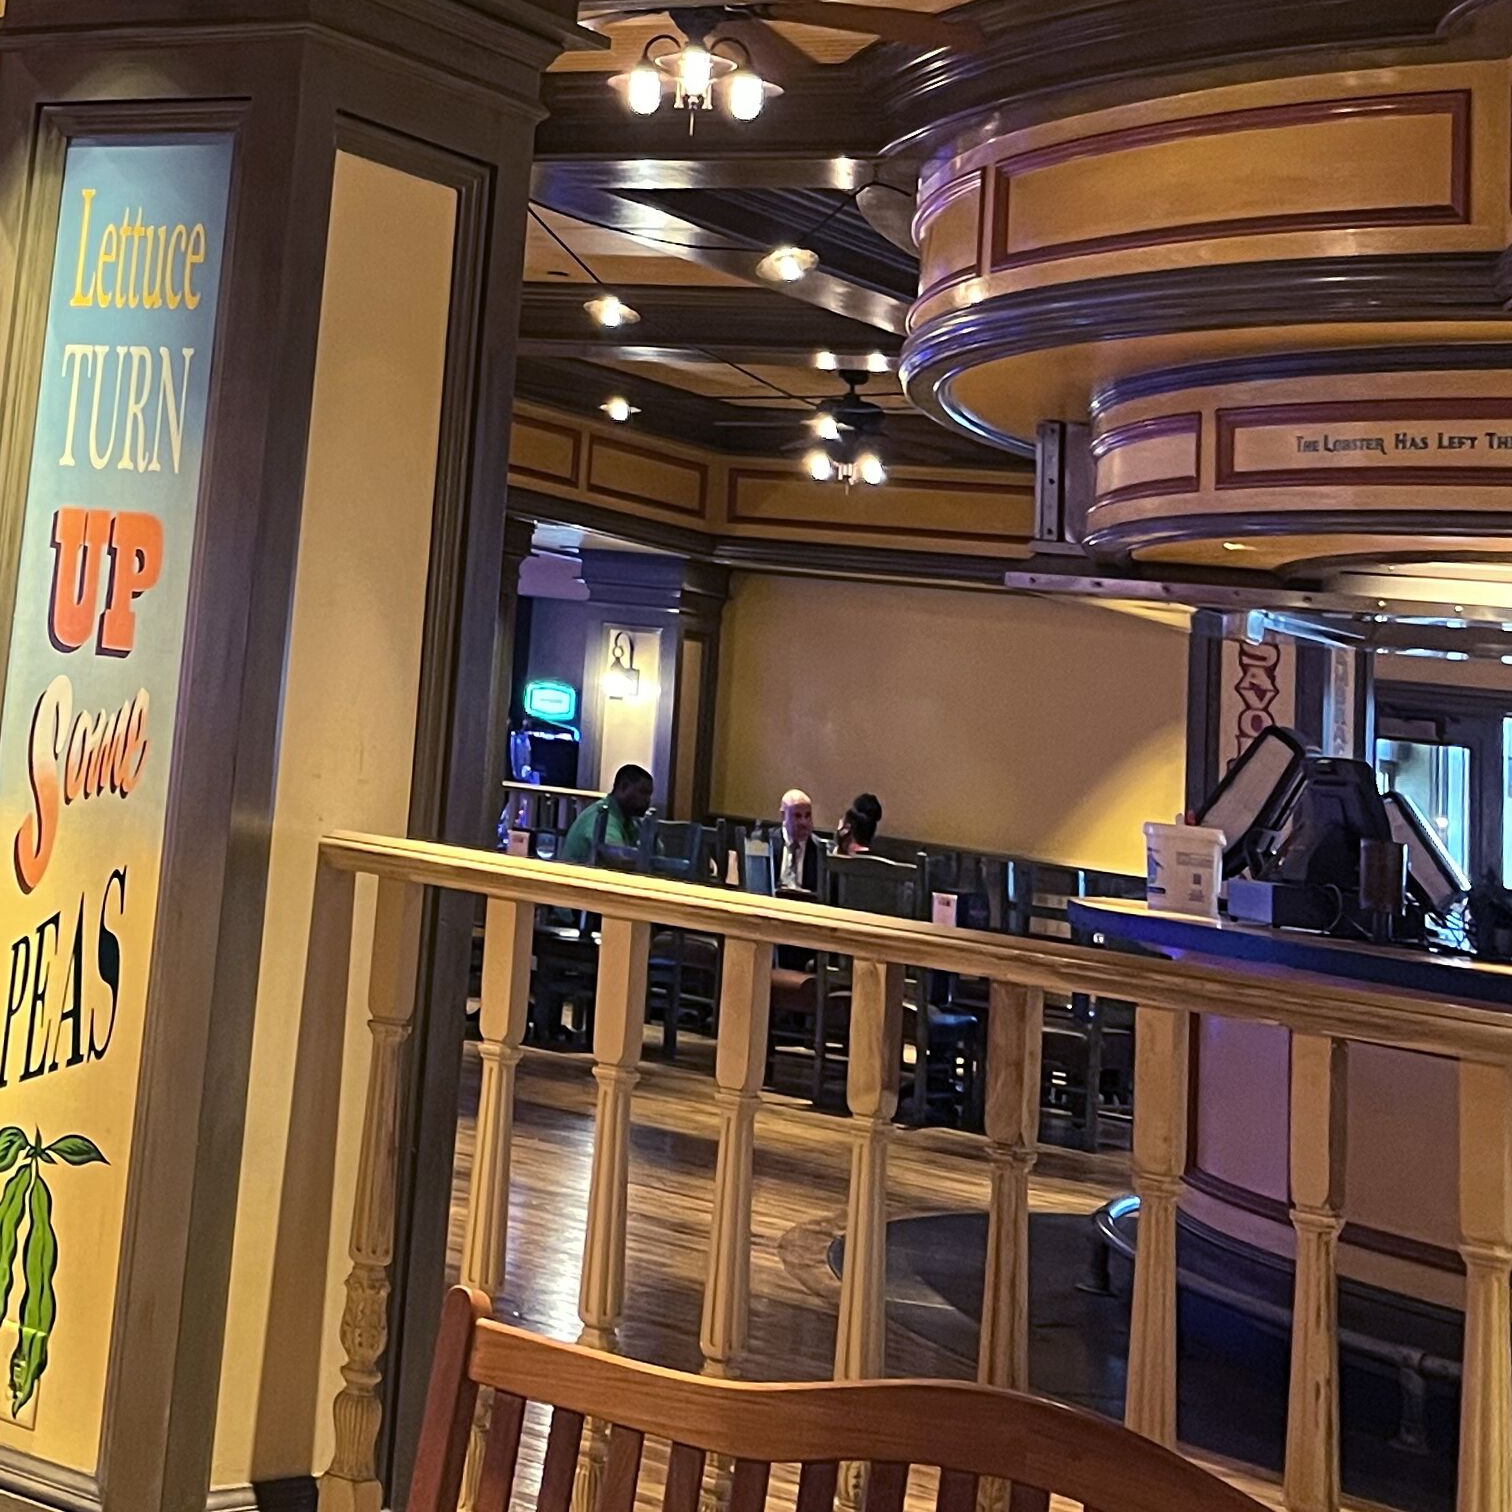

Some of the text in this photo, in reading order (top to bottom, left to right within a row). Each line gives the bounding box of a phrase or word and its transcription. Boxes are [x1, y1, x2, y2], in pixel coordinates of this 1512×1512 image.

[69, 187, 206, 310] Lettuce
[58, 344, 195, 475] TURN
[47, 505, 165, 659] UP
[13, 674, 152, 896] Some
